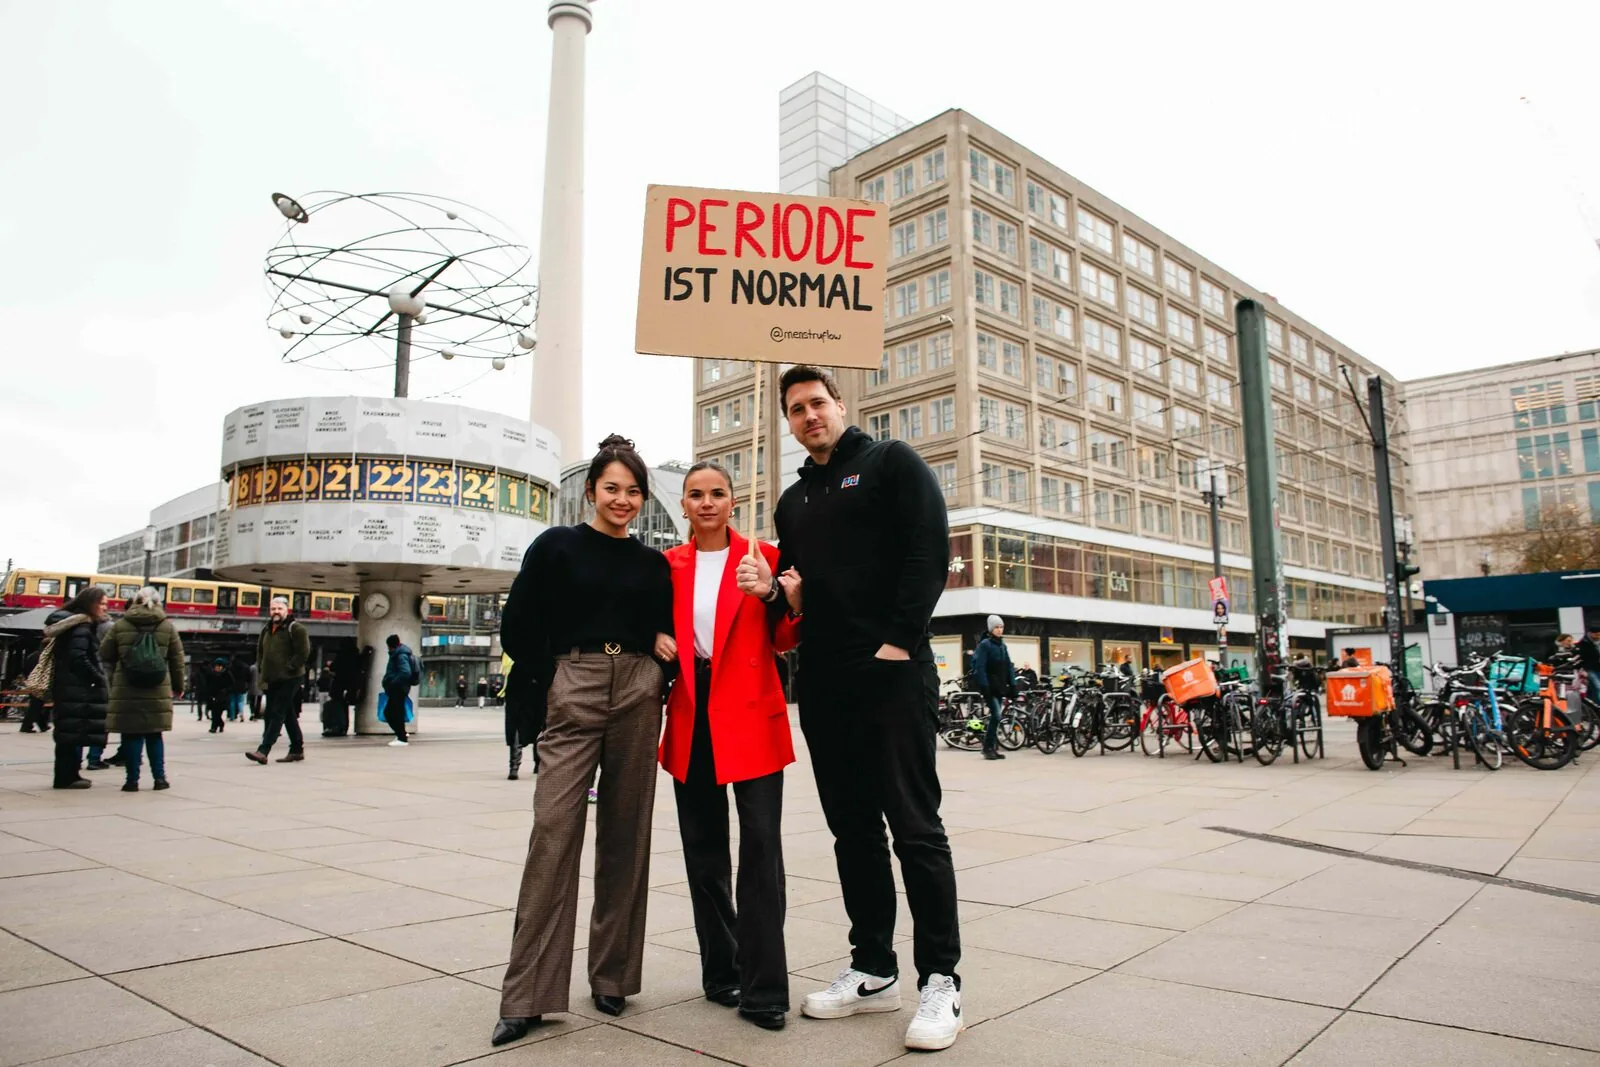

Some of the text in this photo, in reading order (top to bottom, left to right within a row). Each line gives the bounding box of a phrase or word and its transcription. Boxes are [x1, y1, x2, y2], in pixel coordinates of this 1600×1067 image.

[666, 198, 876, 269] PERIODE
[664, 267, 873, 311] IST NORMAL
[770, 326, 842, 343] @menstruflow
[254, 467, 278, 496] 19
[281, 465, 319, 493] 20
[325, 463, 360, 492] 21
[369, 465, 412, 493] 22
[418, 468, 457, 497] 23
[462, 473, 496, 502] 24
[507, 482, 518, 507] 1
[530, 489, 541, 513] 2
